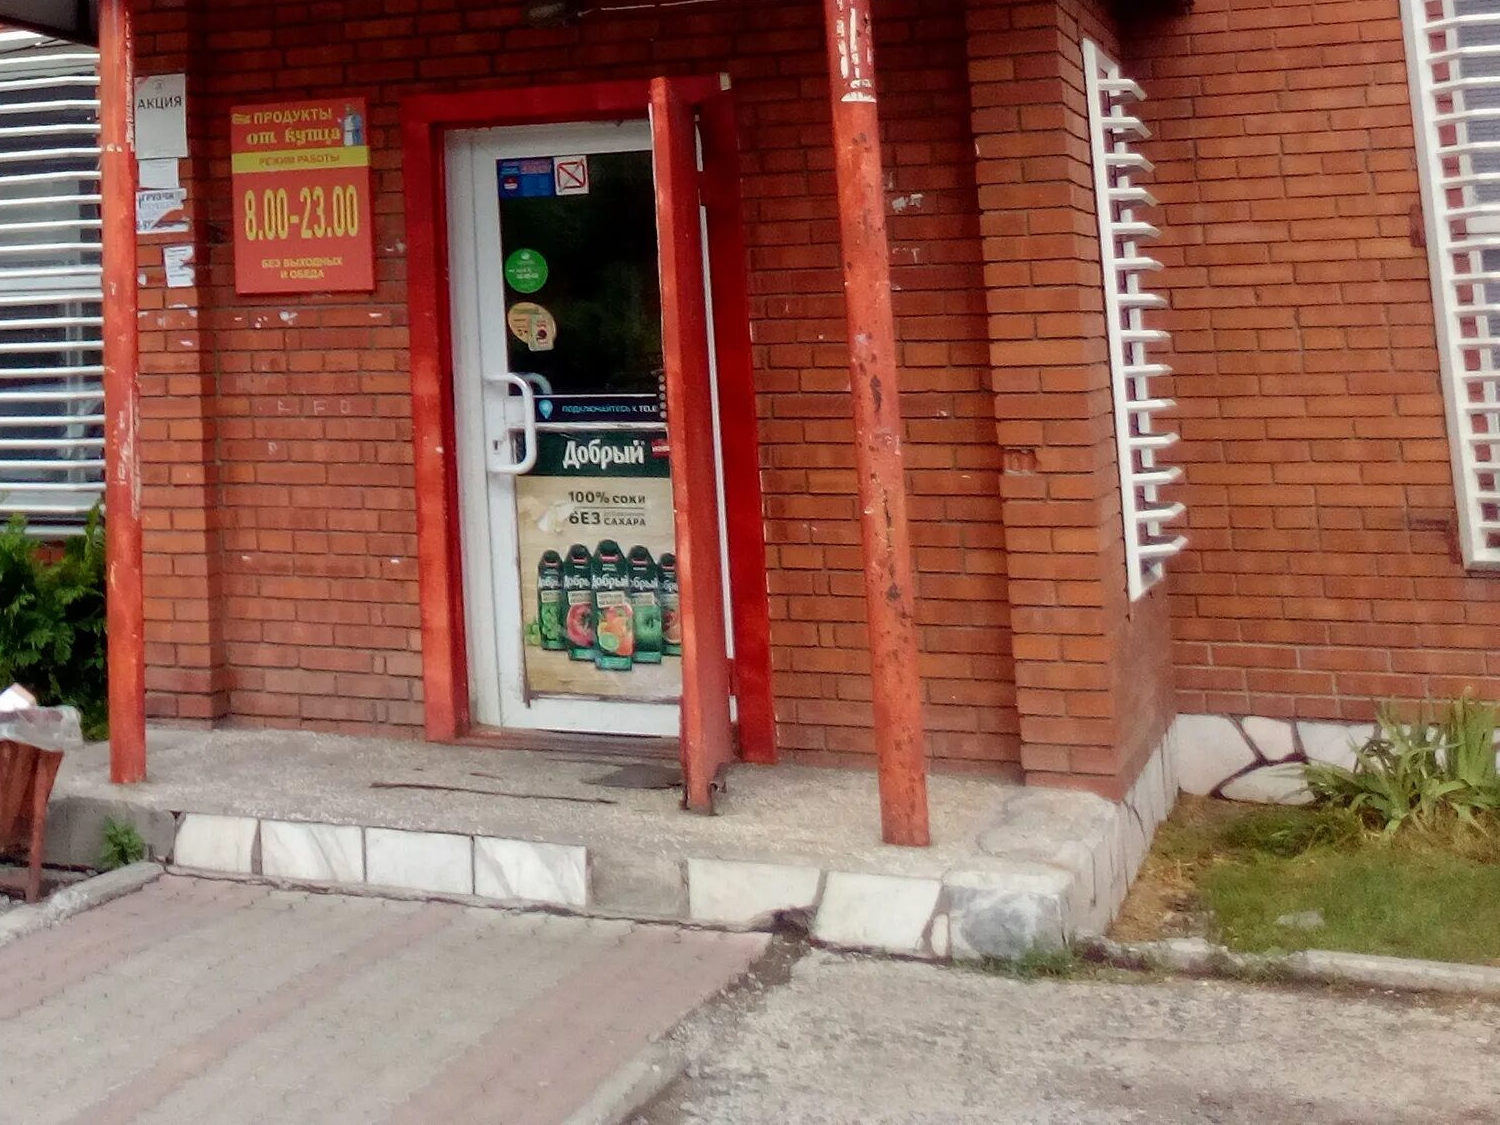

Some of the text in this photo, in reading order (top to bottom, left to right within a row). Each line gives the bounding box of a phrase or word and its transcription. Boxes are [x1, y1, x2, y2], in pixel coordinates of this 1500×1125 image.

[137, 95, 183, 110] АКЦИЯ
[254, 107, 332, 125] ПРОДУКТЫ
[246, 126, 341, 146] от купца
[297, 153, 341, 165] РАБОТЫ
[244, 184, 359, 242] 8.00-23.00
[261, 256, 343, 269] БЕЗ ВЫХОДНЫХ
[289, 269, 325, 280] ОБЕДА
[562, 439, 645, 470] Добрый
[568, 490, 610, 504] 100%
[603, 516, 646, 526] САХАРА
